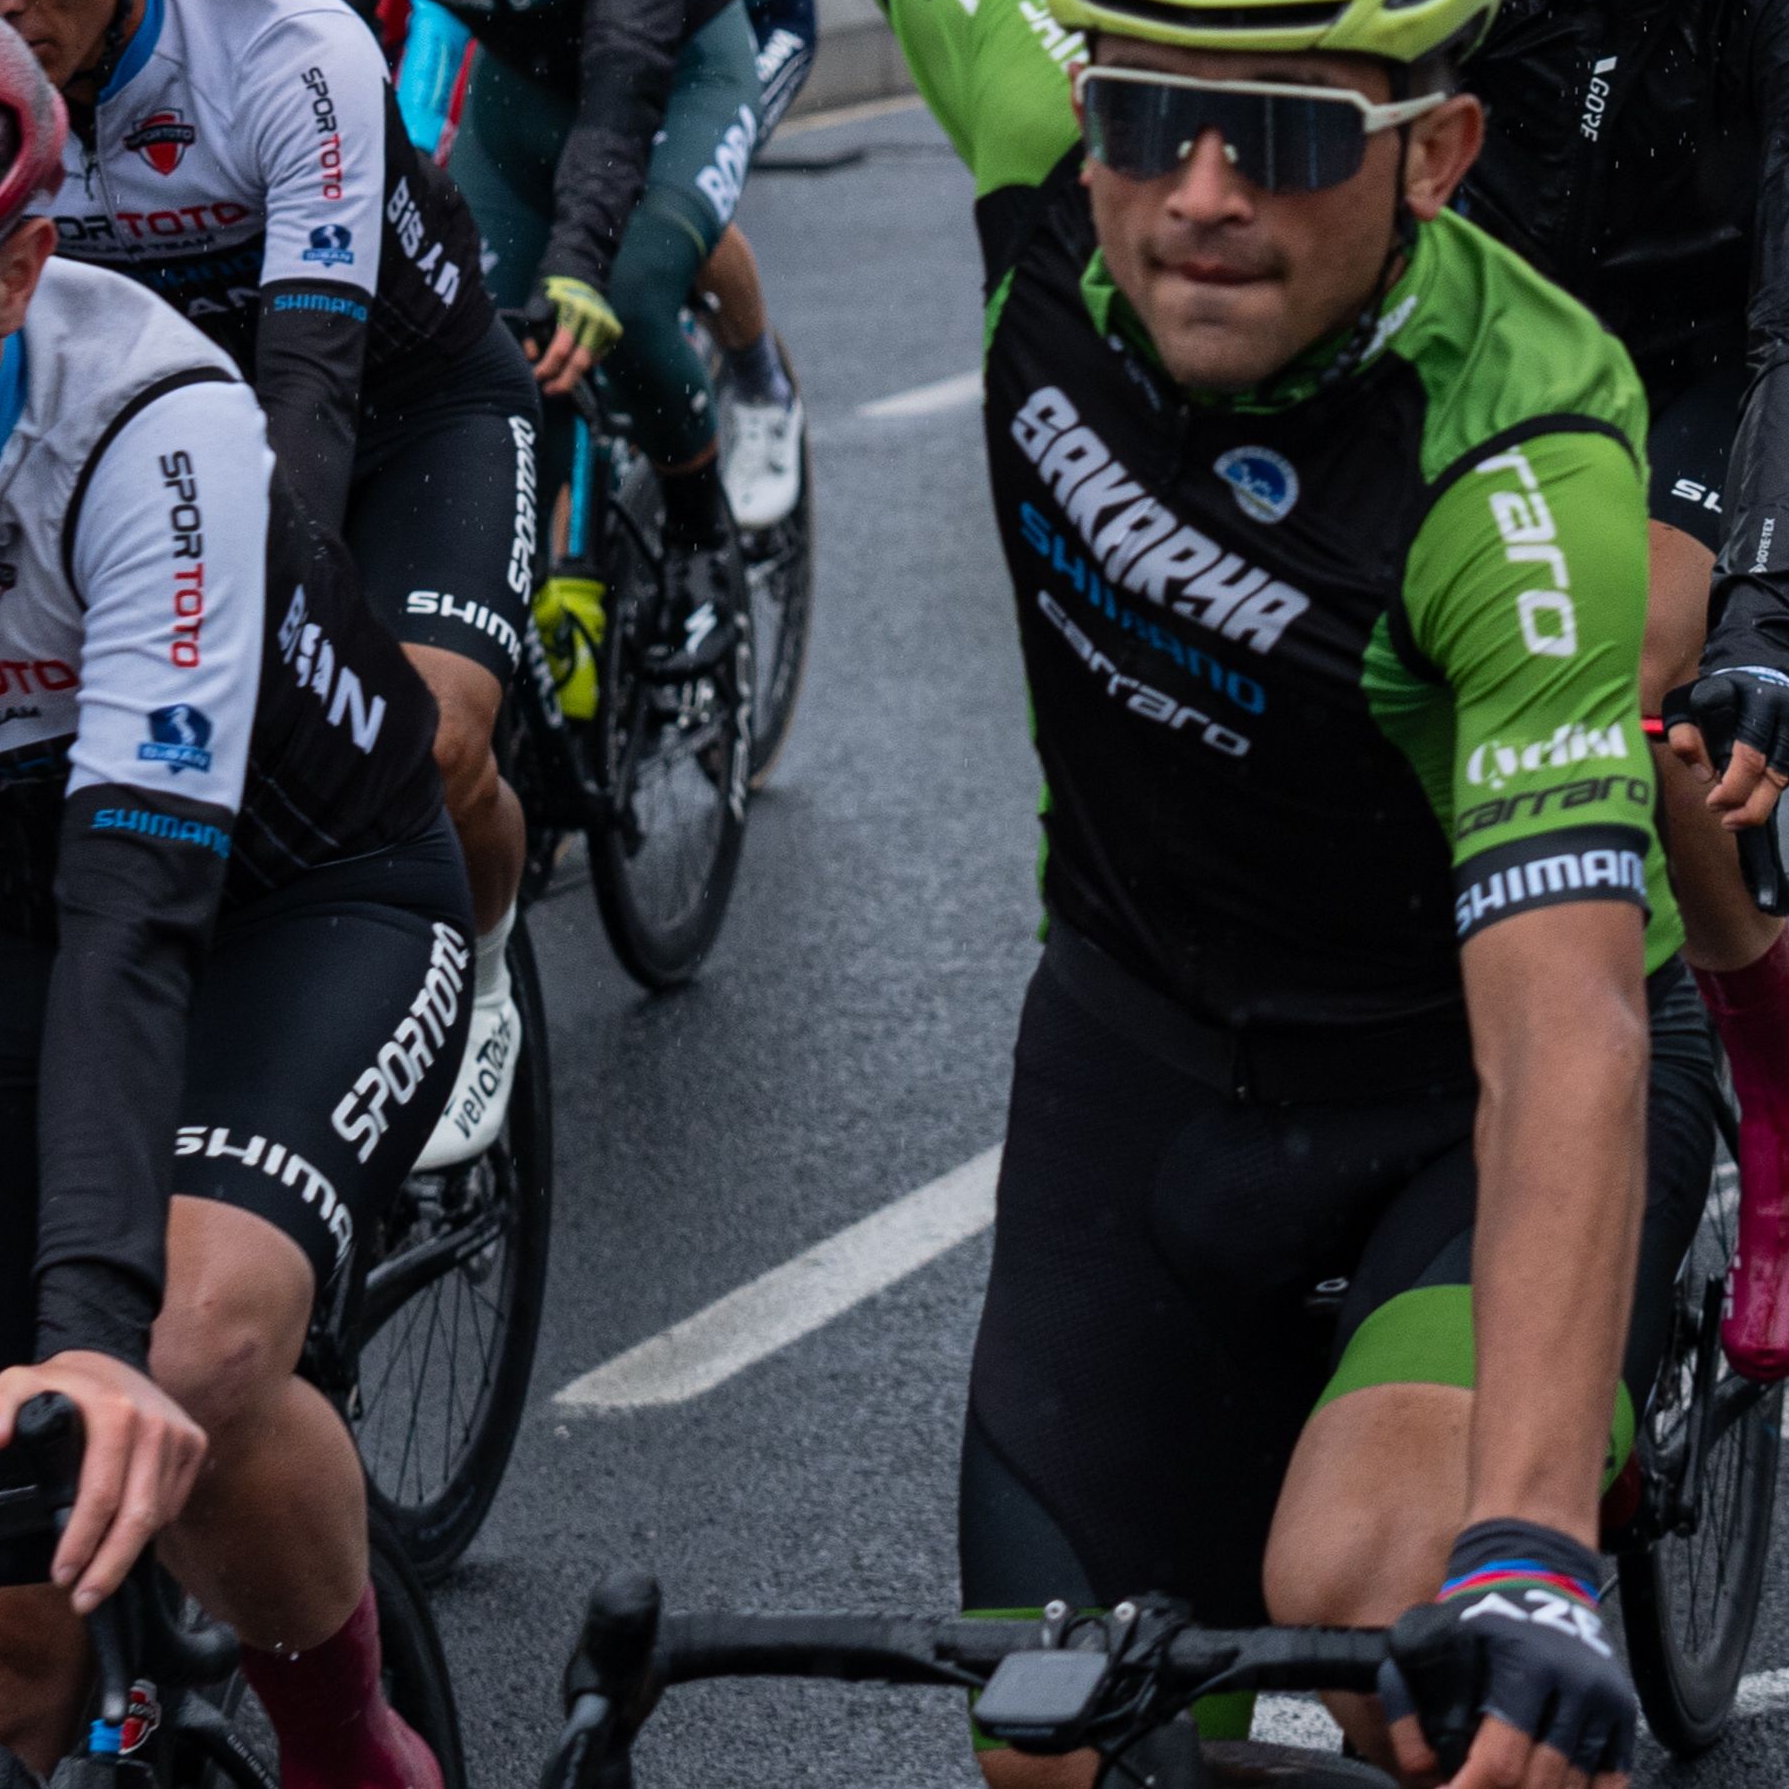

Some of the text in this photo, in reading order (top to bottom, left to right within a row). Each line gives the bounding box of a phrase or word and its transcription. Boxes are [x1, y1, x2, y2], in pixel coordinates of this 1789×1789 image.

[300, 66, 343, 200] SPORTOTO
[1579, 77, 1611, 143] GORE
[54, 202, 249, 240] ORTOTO
[158, 450, 206, 670] SPORTOTO
[1011, 385, 1310, 656] SAKARYA
[1476, 445, 1579, 658] raro
[1756, 517, 1776, 565] GORE-TEX
[406, 590, 522, 663] SHIM
[1018, 500, 1266, 715] SHIMANO
[1037, 588, 1252, 758] carraro
[1457, 775, 1651, 842] carraro
[1455, 850, 1647, 938] SHIMAN
[173, 1125, 354, 1261] SHIMA
